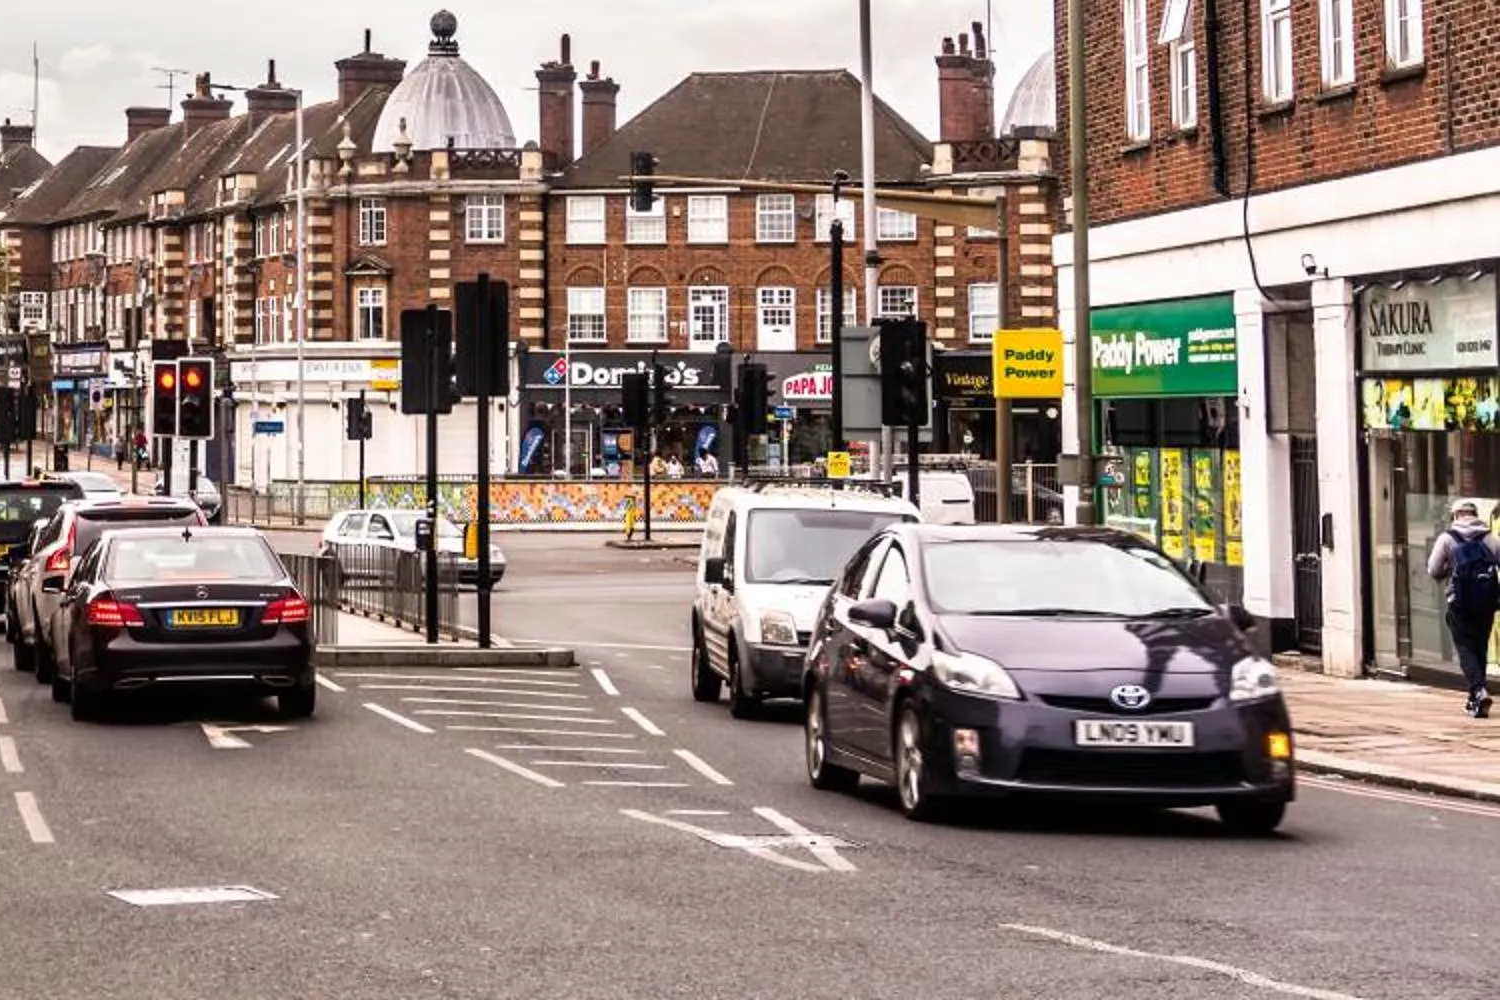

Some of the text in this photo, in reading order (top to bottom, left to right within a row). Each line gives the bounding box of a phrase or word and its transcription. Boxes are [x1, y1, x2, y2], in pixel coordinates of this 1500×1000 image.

[1369, 299, 1433, 337] SAKURA
[1004, 349, 1055, 362] Paddy
[1092, 331, 1181, 375] Paddy Power
[1005, 367, 1056, 379] Power
[786, 376, 816, 395] PAPA
[1085, 723, 1185, 743] LN09 YMU
